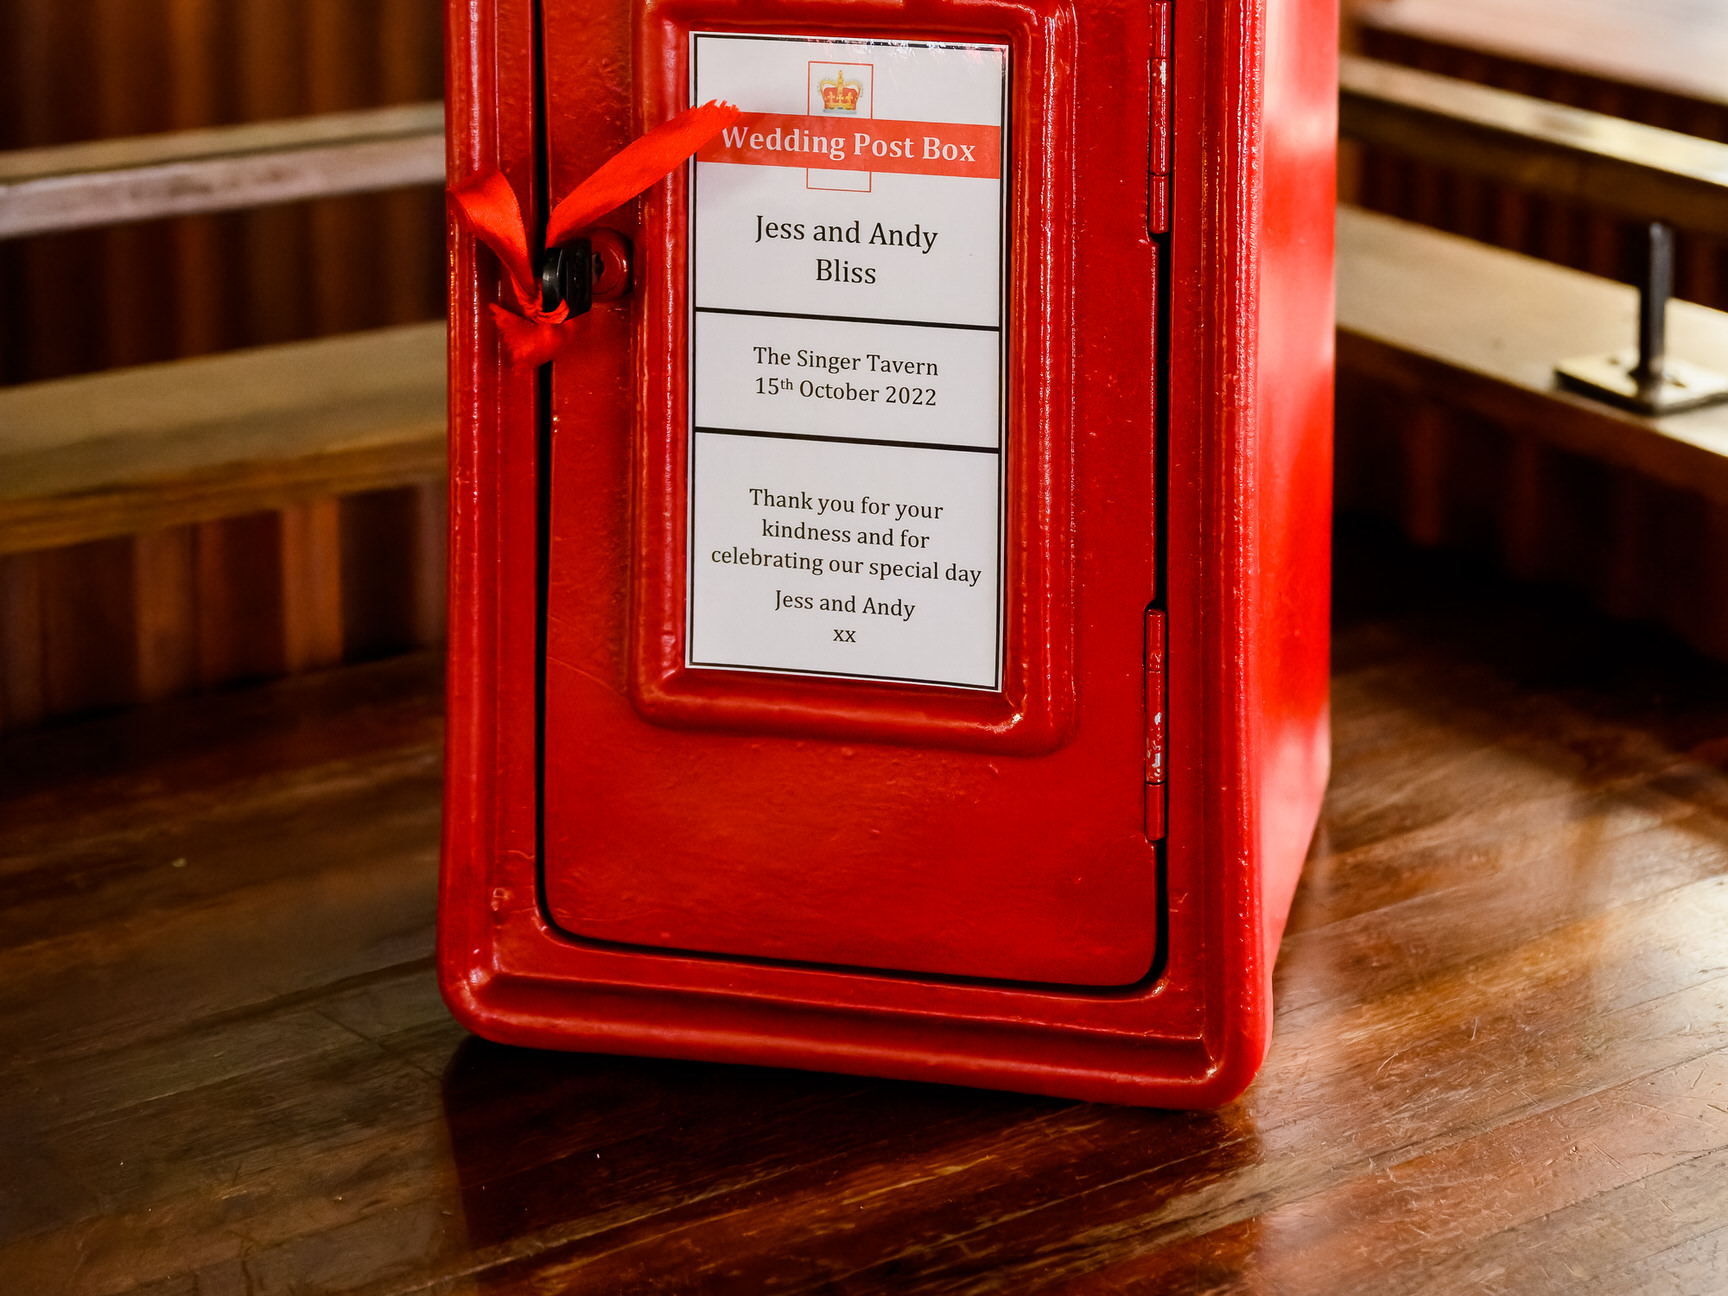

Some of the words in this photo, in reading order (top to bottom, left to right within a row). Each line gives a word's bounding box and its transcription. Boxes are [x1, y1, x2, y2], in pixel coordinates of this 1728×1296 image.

[722, 126, 846, 161] Wedding
[853, 132, 914, 159] Post
[922, 136, 976, 162] Box
[754, 215, 805, 244] Jess
[812, 220, 861, 244] and
[868, 222, 939, 255] Andy
[815, 258, 876, 285] Bliss
[753, 346, 791, 366] The
[797, 349, 862, 375] Singer
[866, 353, 939, 377] Tavern
[755, 376, 794, 396] 15th
[799, 379, 880, 403] October
[885, 385, 936, 407] 2022
[749, 488, 813, 510] Thank
[817, 498, 855, 516] you
[861, 495, 891, 516] for
[894, 503, 944, 522] your
[761, 518, 851, 543] kindness
[857, 528, 894, 547] and
[900, 529, 930, 549] for
[711, 546, 824, 576] celebrating
[828, 559, 864, 574] our
[868, 561, 939, 581] special
[945, 562, 982, 588] day
[774, 589, 814, 611] Jess
[819, 594, 856, 614] and
[861, 596, 916, 622] Andy
[832, 628, 857, 643] xx
